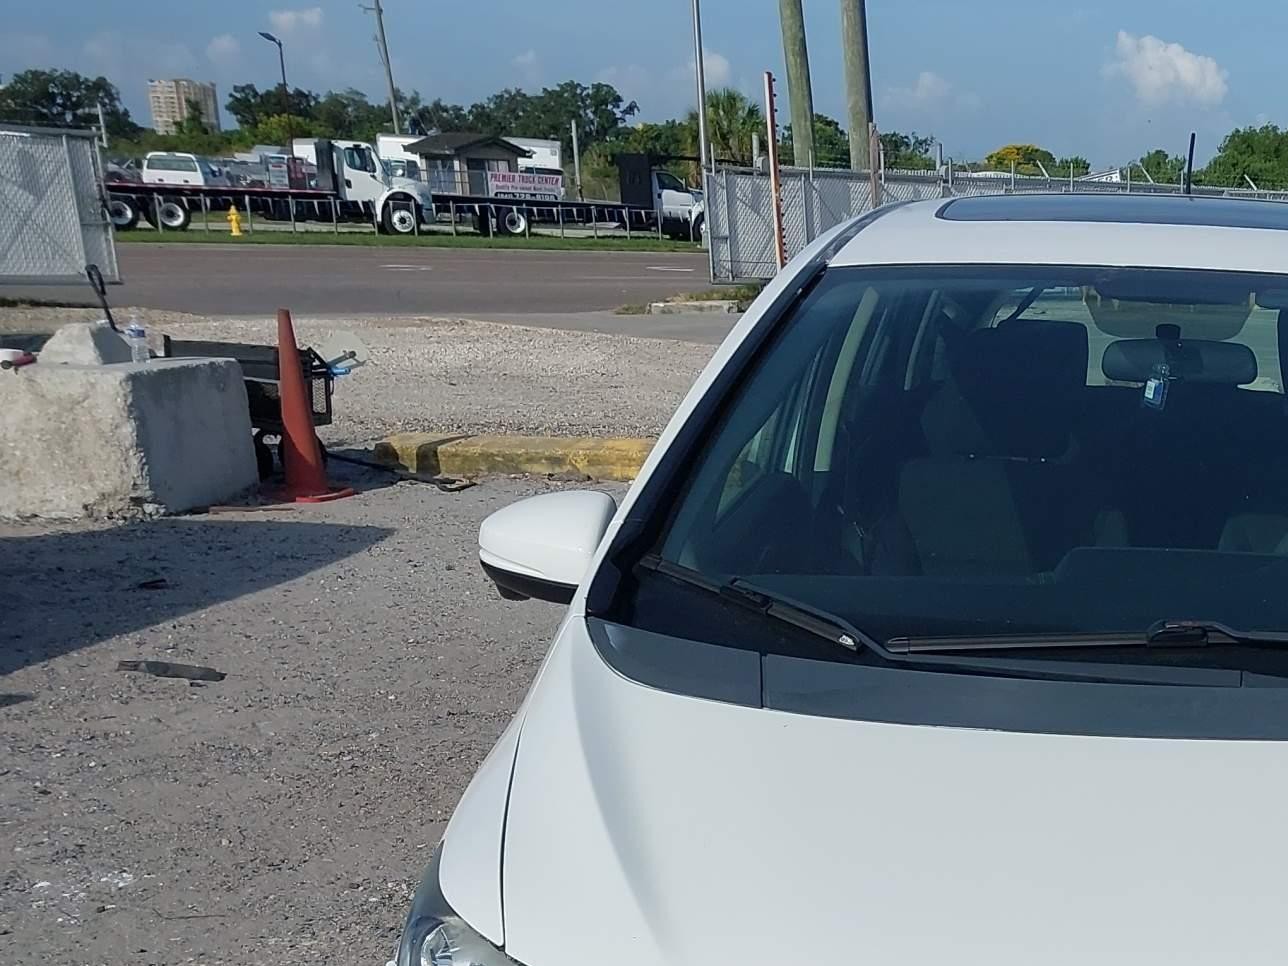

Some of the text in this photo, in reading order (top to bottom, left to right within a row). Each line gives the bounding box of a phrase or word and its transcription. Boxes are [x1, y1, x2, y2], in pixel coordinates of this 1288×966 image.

[490, 173, 560, 186] PREMIER TRUCK CENTER
